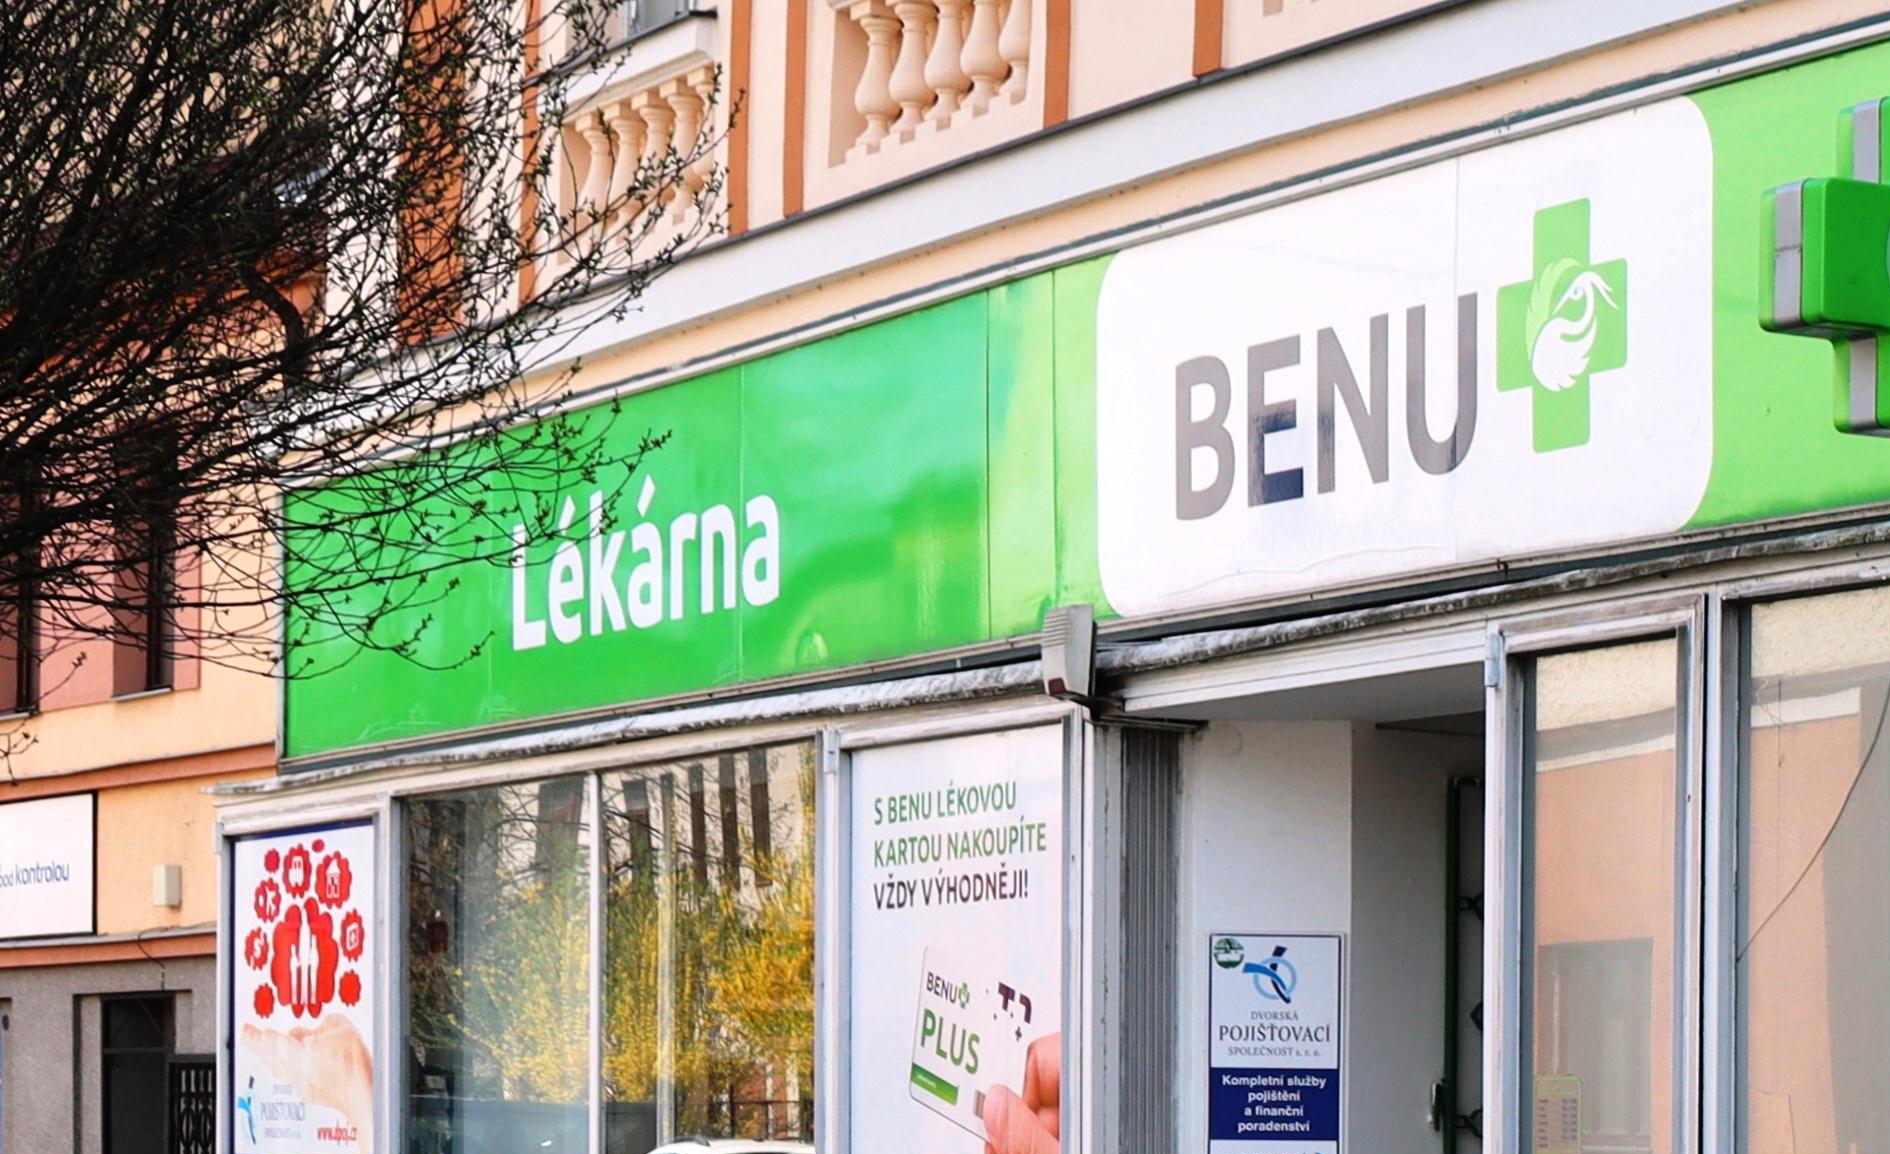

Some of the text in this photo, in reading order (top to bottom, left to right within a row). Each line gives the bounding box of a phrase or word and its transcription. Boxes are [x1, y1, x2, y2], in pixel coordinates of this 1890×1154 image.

[1173, 290, 1478, 520] BENU
[513, 474, 780, 651] Lékárna
[874, 780, 1016, 826] S BENU LÉKOVOU
[874, 815, 1047, 868] KARTOU NAKOUPÍTE
[15, 860, 70, 885] kontrolou
[873, 862, 1029, 911] VŽDY VÝHODNĚJI!
[926, 971, 958, 1004] BENU
[1251, 1010, 1299, 1021] DVORSKÁ
[921, 1008, 980, 1075] PLUS
[1219, 1022, 1331, 1042] POJIŠŤOVACÍ
[1227, 1046, 1294, 1057] SPOLEČNOST
[1222, 1074, 1327, 1089] Kompletní služby
[1248, 1090, 1301, 1103] pojištění
[1244, 1105, 1304, 1116] a finanční
[1238, 1120, 1310, 1133] poradenství
